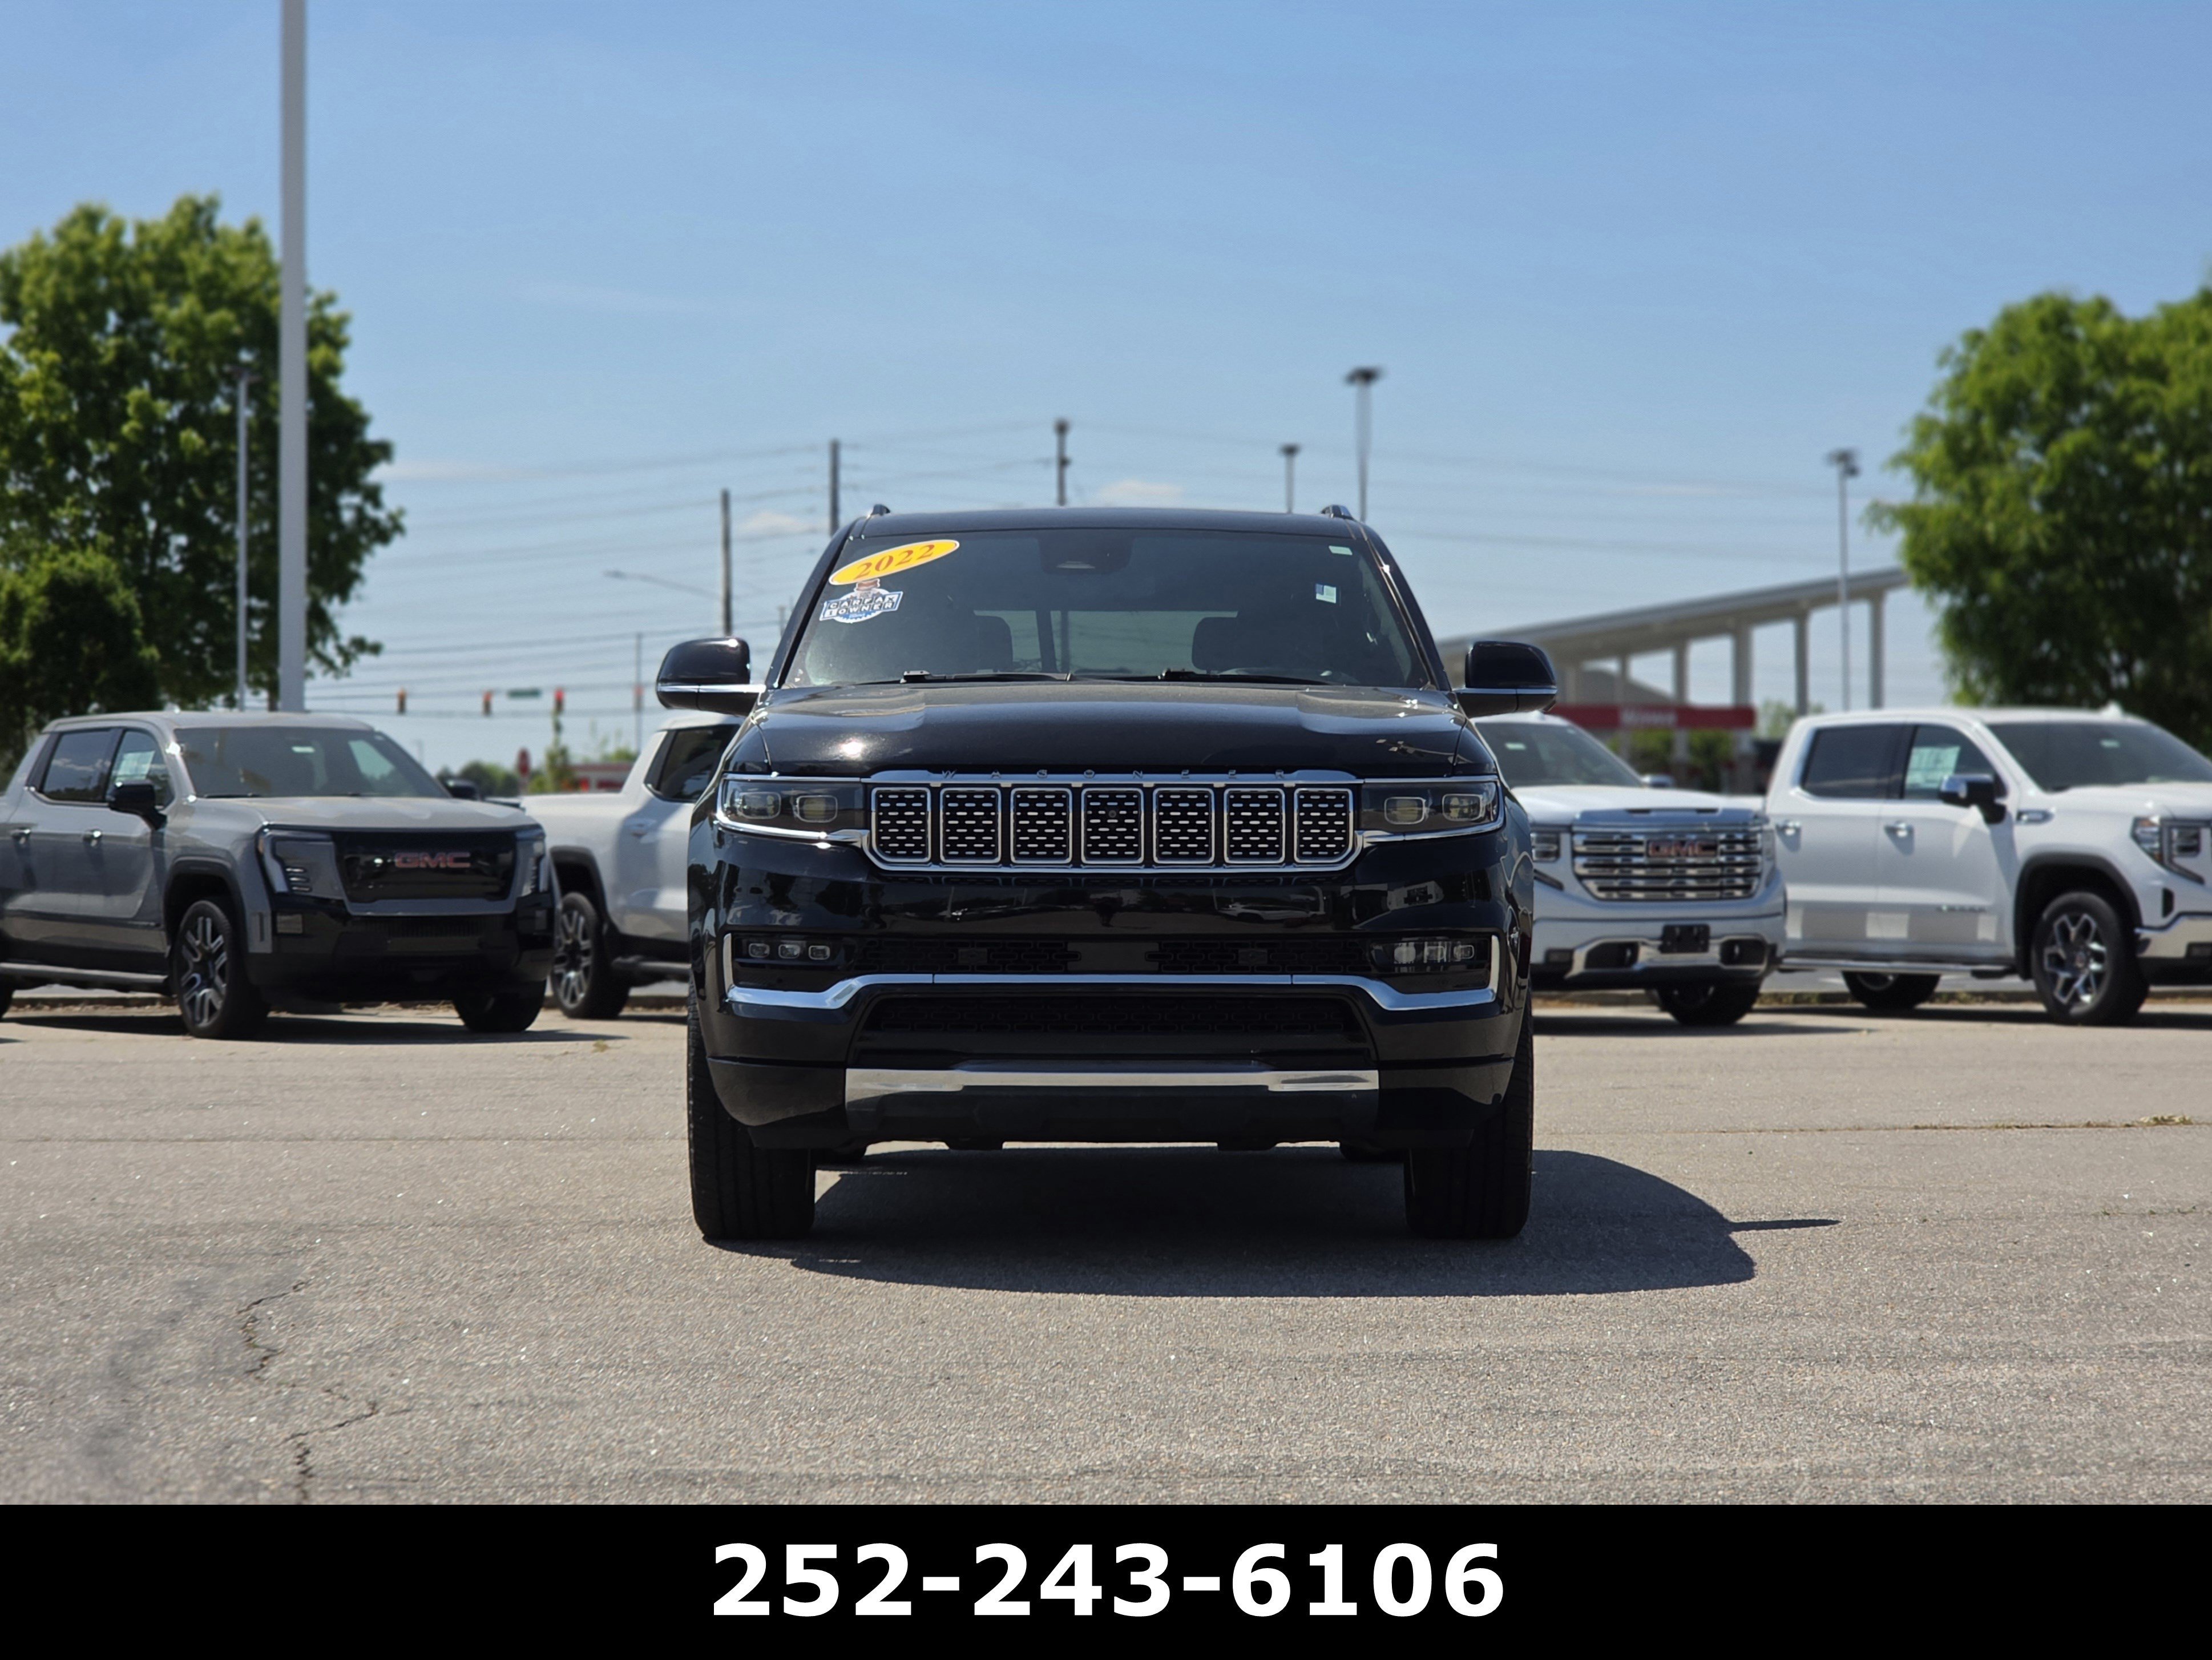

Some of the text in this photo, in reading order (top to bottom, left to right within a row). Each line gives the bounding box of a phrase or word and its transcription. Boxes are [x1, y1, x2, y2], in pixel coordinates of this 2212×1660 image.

[853, 544, 935, 580] 2022
[829, 595, 895, 610] CARFAX
[838, 602, 893, 614] OWNER
[941, 769, 1285, 779] WAGONEER
[1649, 840, 1715, 857] GMC
[394, 852, 471, 868] GMC
